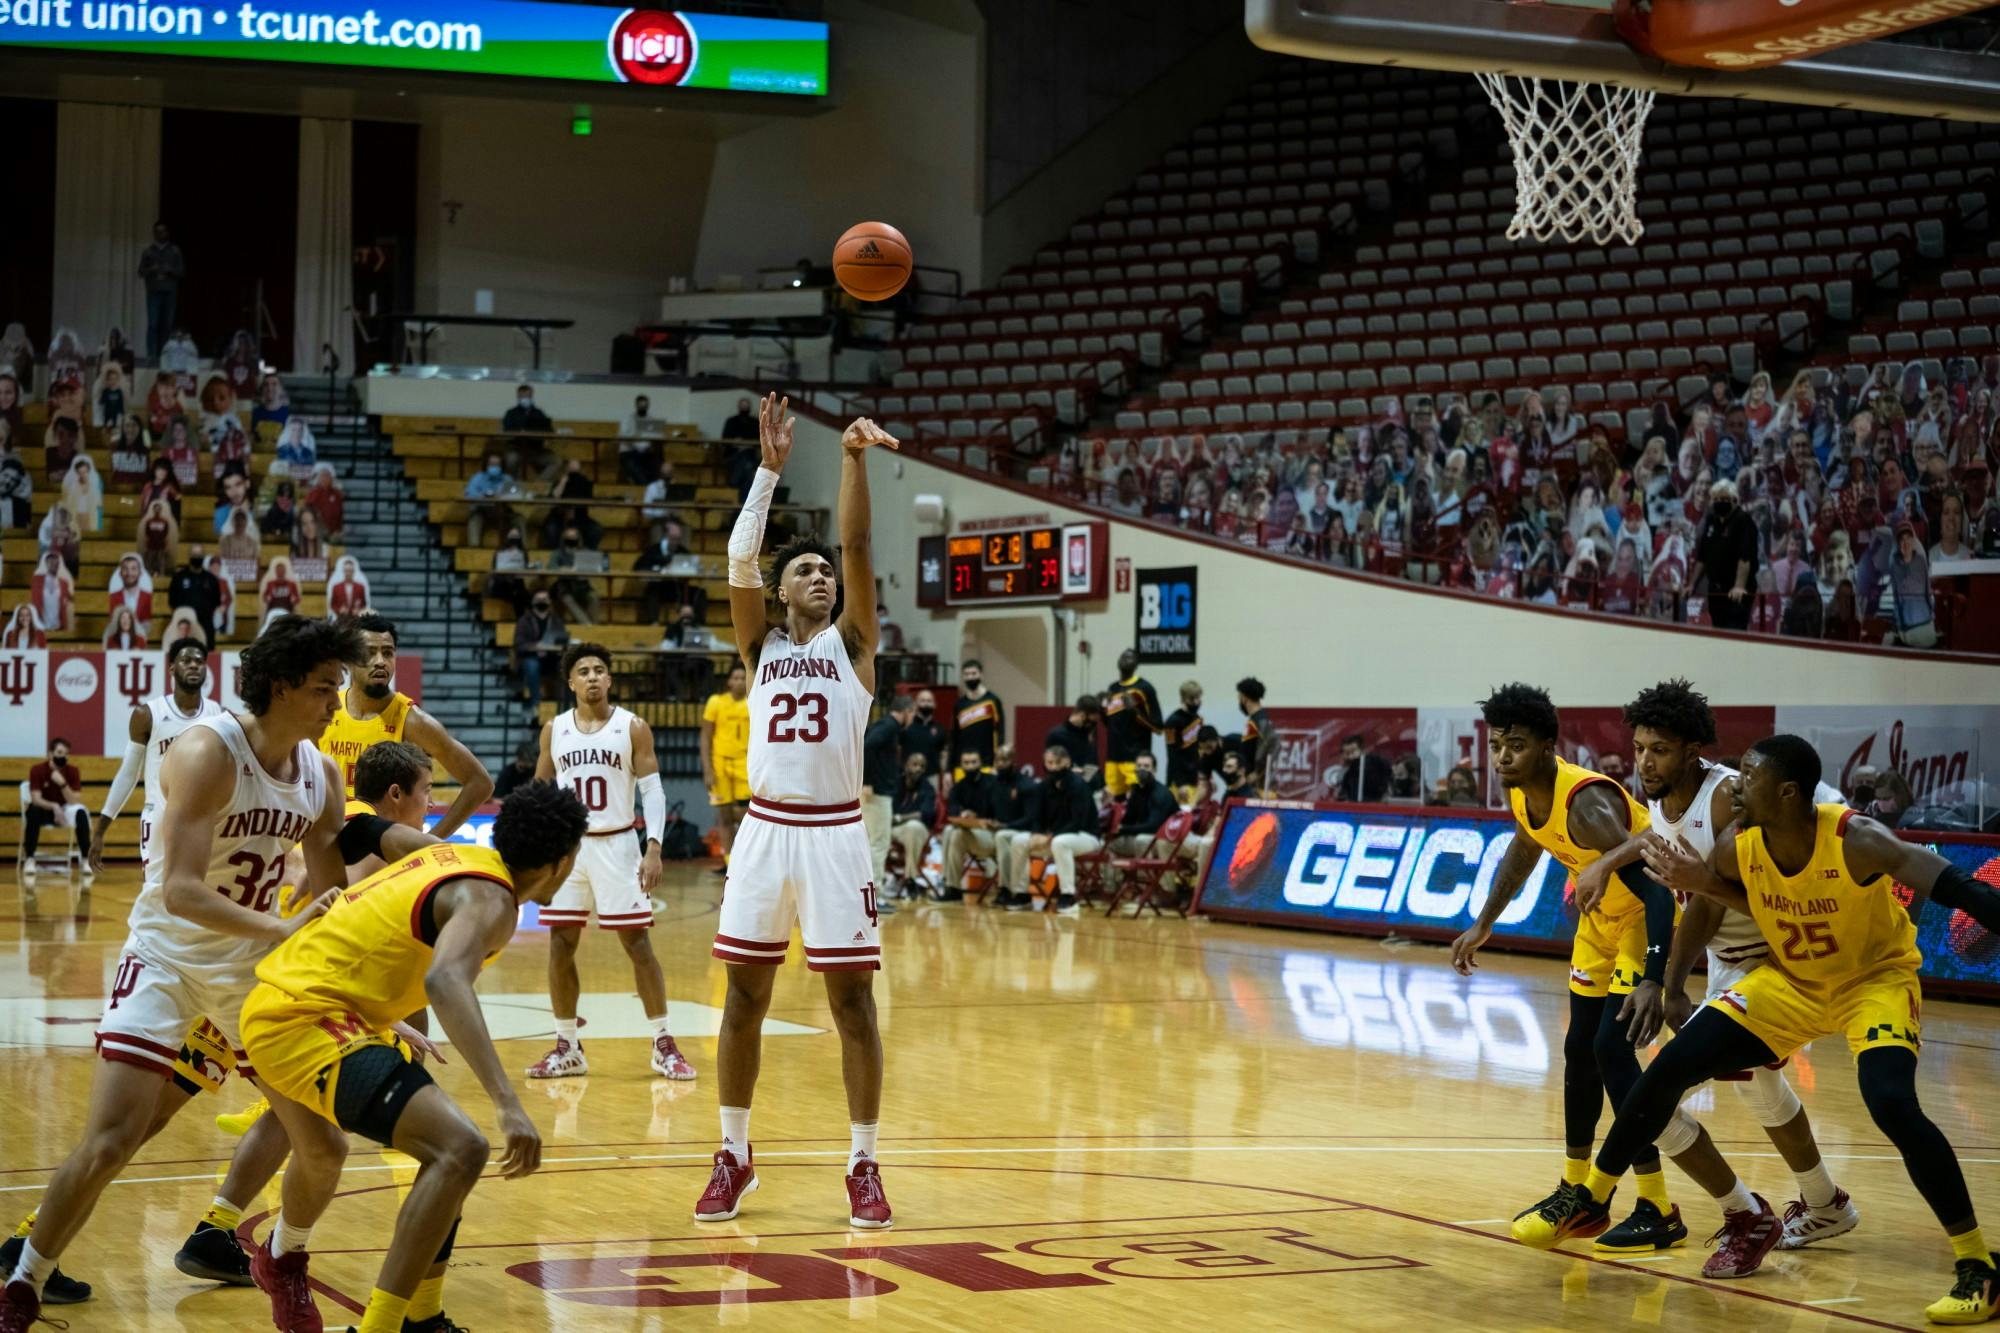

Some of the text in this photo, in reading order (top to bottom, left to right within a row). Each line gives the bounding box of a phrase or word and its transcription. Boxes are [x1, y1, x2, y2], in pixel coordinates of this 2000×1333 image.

[83, 0, 202, 35] union
[238, 4, 482, 51] tcunet.com
[1041, 558, 1057, 588] 39
[761, 657, 841, 686] INDIANA
[768, 693, 828, 743] 23
[559, 748, 623, 772] INDIANA
[1273, 740, 1311, 769] EAL
[573, 775, 608, 811] 10
[219, 808, 313, 844] INDIAN
[216, 851, 285, 912] 32
[1283, 821, 1553, 925] GEICO
[1761, 892, 1839, 917] MARYLAND
[1776, 919, 1840, 962] 25
